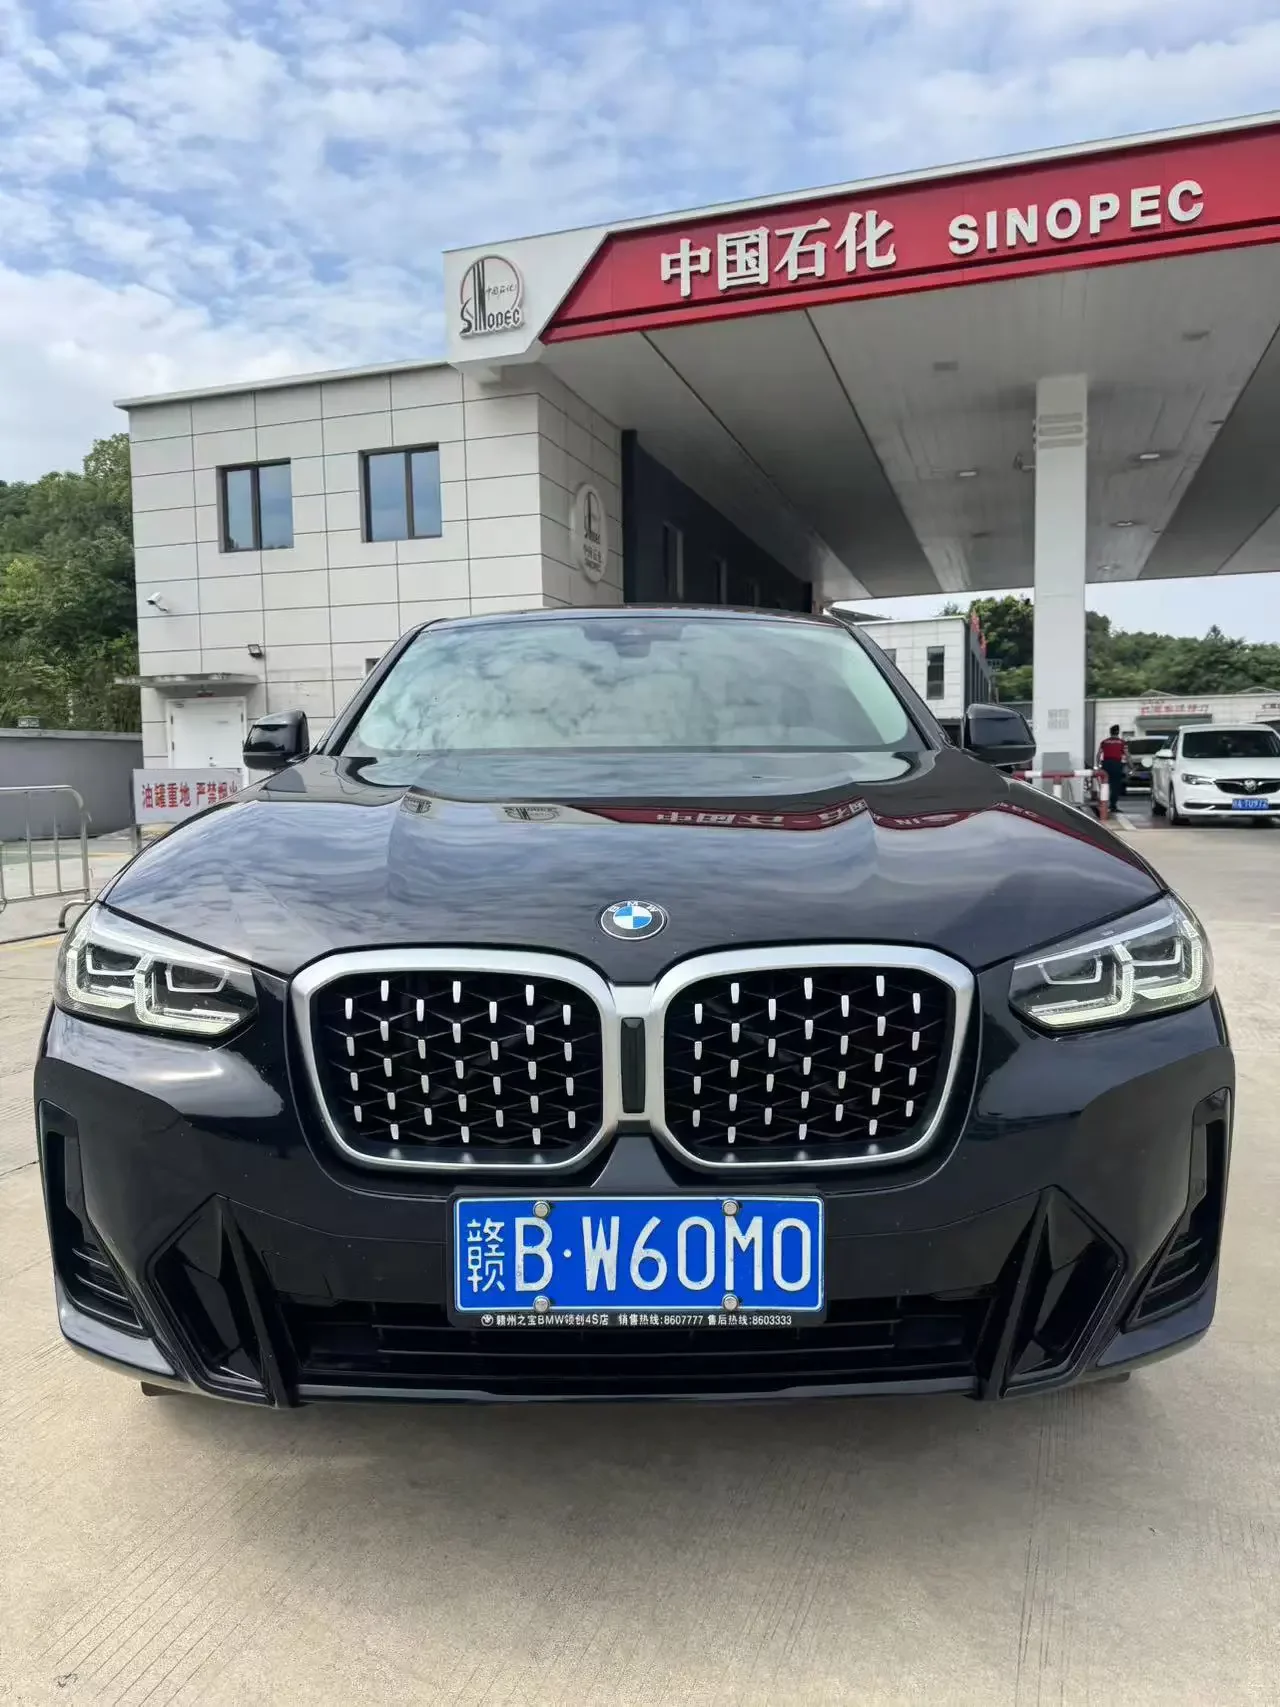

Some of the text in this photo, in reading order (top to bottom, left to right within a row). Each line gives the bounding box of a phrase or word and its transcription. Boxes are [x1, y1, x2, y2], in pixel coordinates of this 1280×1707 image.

[660, 179, 1204, 297] 中国石化 SINOPEC
[142, 782, 191, 808] 油罐重地
[608, 900, 659, 913] BMW
